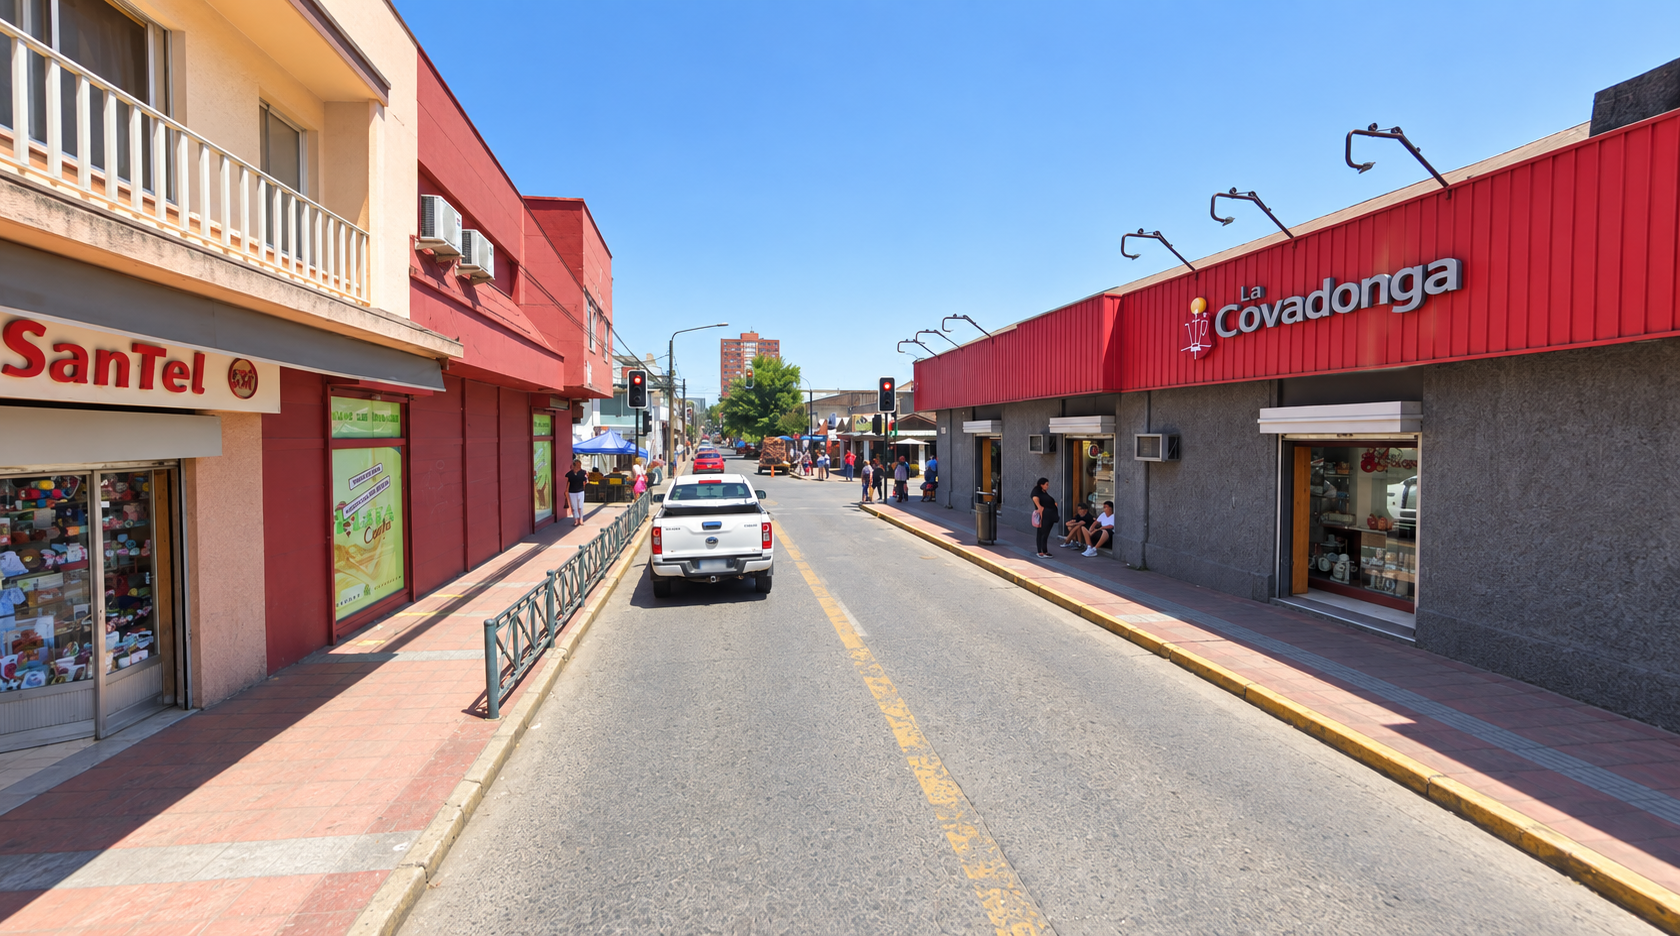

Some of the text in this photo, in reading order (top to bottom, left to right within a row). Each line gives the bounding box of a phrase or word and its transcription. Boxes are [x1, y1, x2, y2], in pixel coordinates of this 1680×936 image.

[1214, 257, 1463, 339] Covadonga
[1240, 286, 1265, 302] La
[1, 319, 206, 395] SanTel
